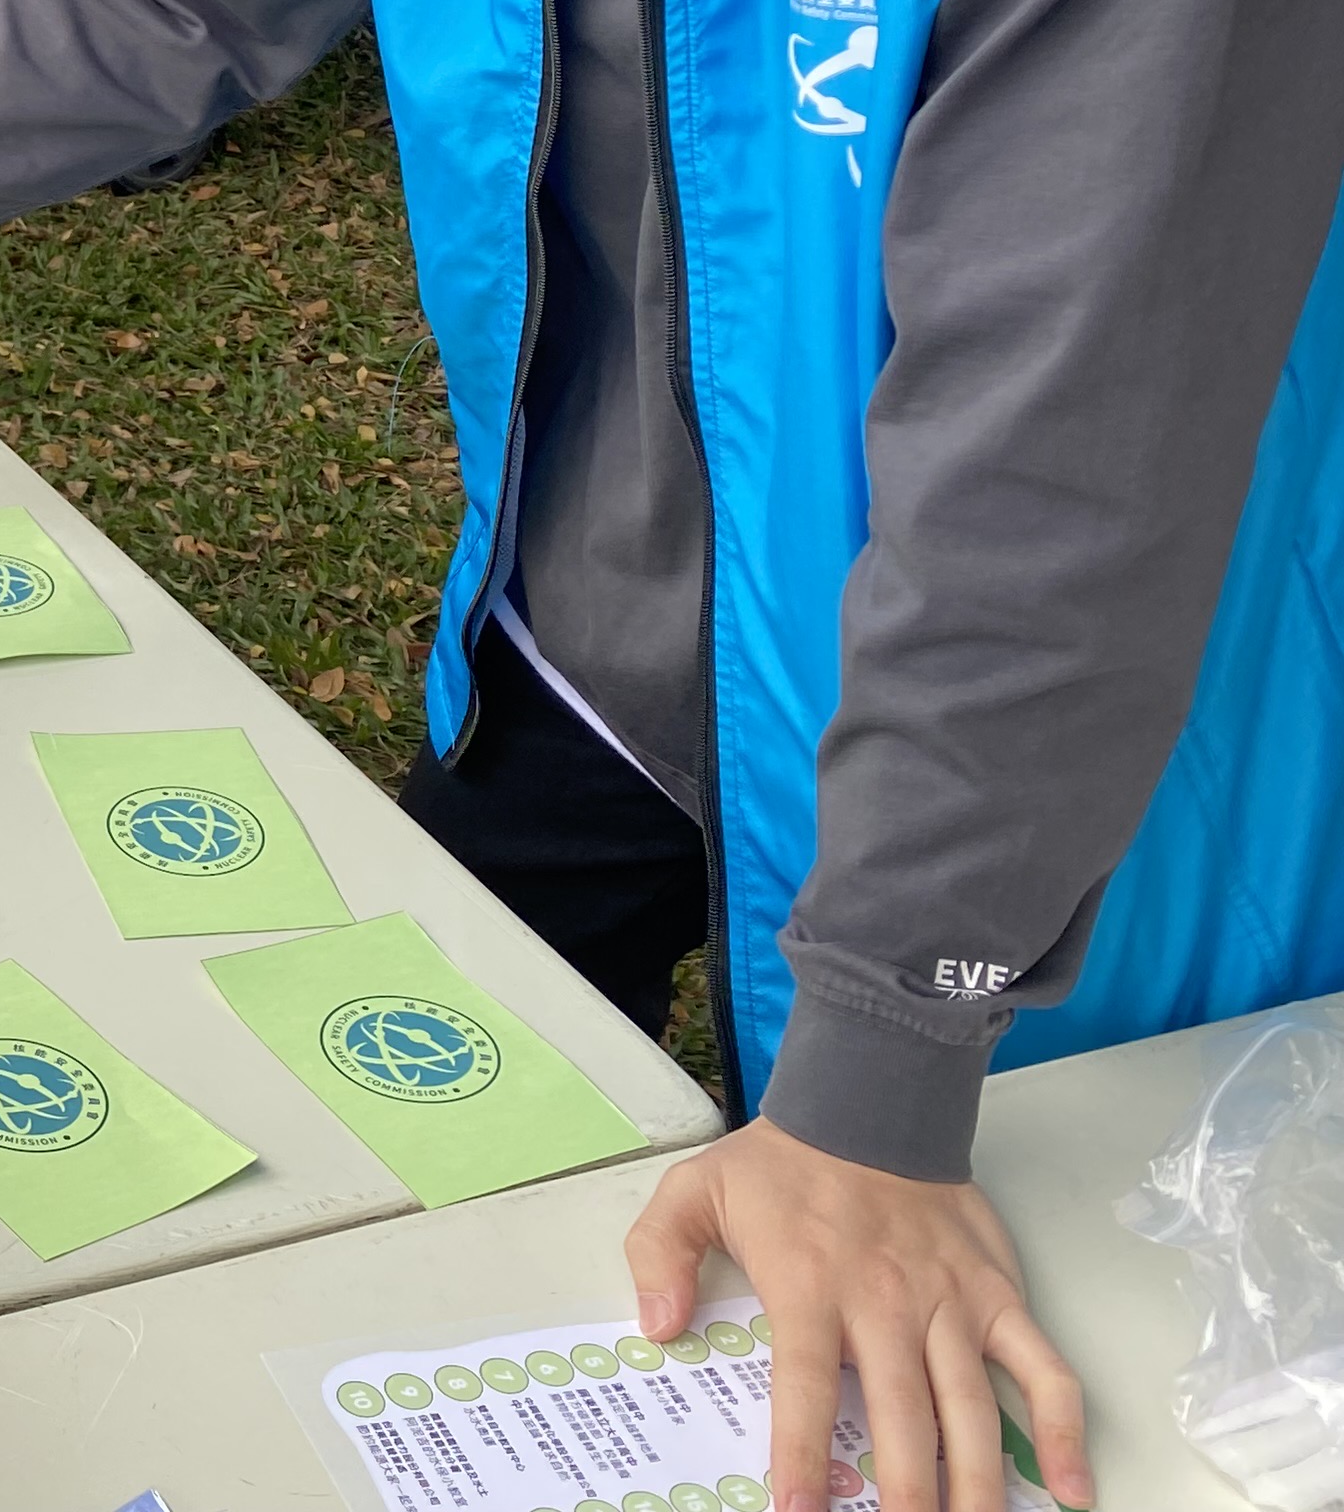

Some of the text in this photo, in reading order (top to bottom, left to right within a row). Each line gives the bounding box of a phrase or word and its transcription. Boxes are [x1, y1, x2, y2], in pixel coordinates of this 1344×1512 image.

[175, 791, 240, 815] COMMISSION
[215, 847, 252, 869] NUCLEAR
[331, 1009, 447, 1096] NUCLEAR SAFETY COMMISSION
[718, 1334, 739, 1345] 2
[674, 1341, 696, 1352] 3
[627, 1348, 649, 1360] 4
[582, 1356, 604, 1368] 5
[537, 1363, 559, 1375] 6
[492, 1370, 514, 1382] 7
[445, 1377, 469, 1390] 8
[397, 1385, 419, 1398] 9
[346, 1389, 374, 1410] 10
[726, 1483, 756, 1505] 14
